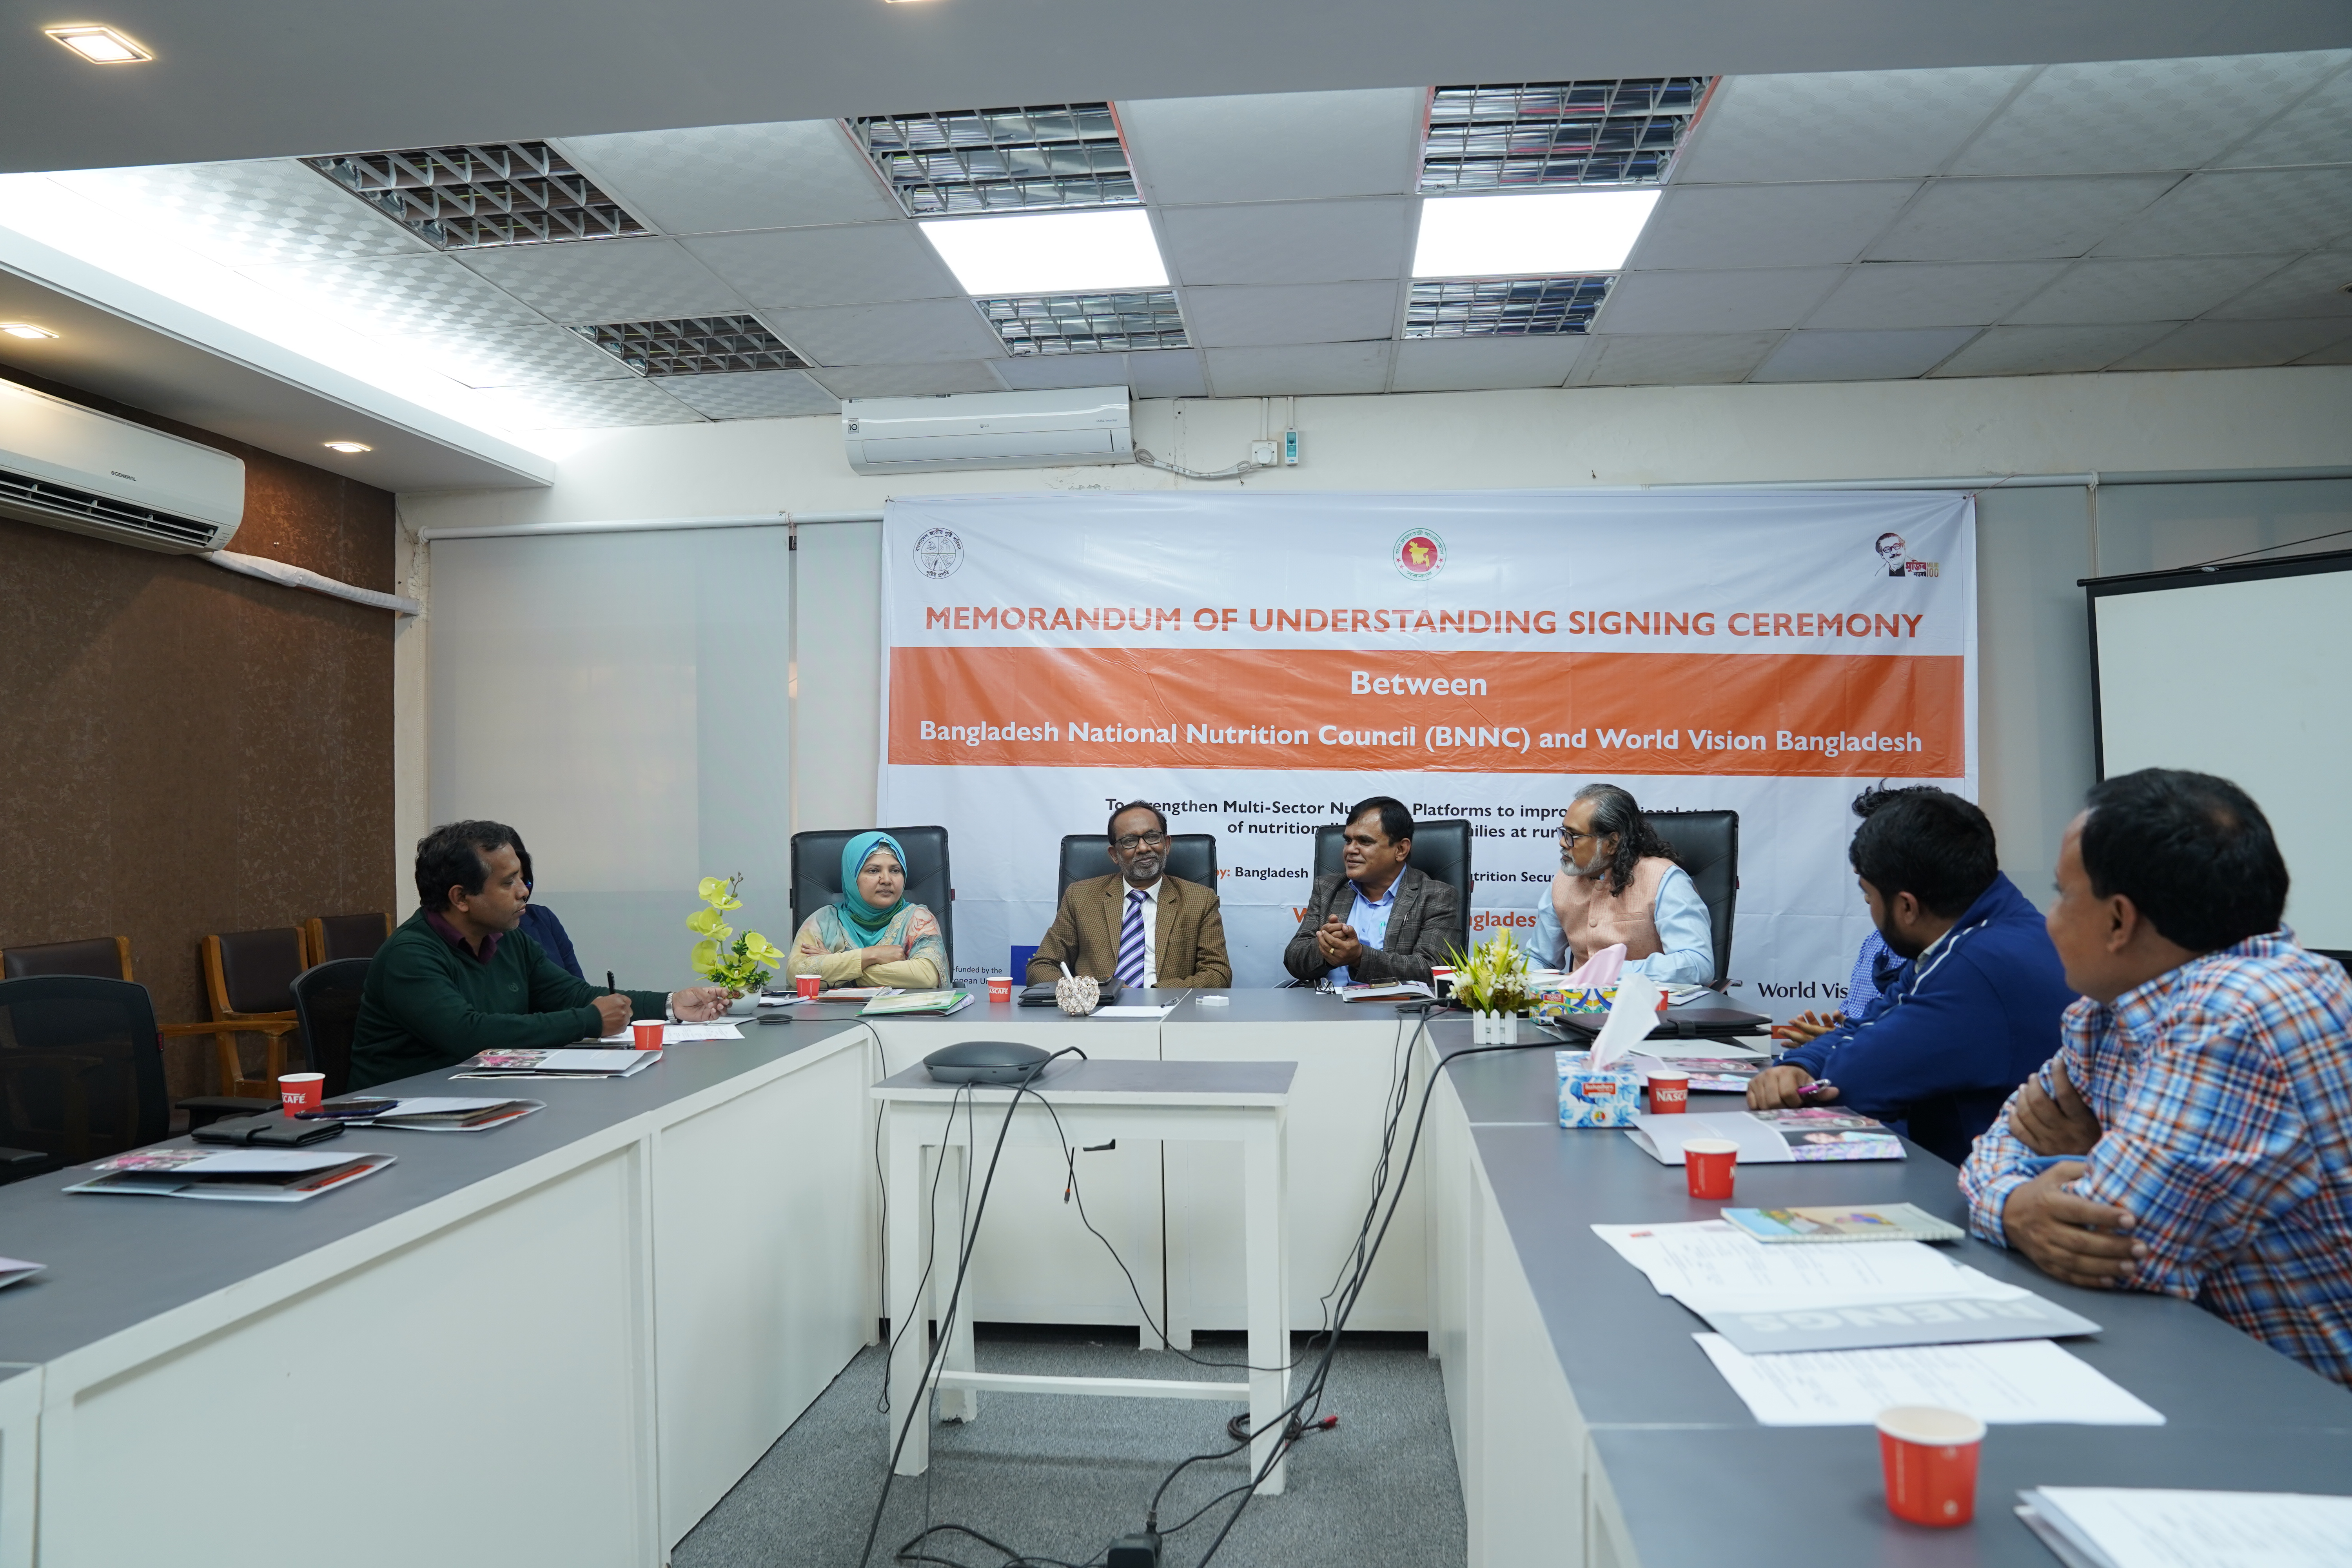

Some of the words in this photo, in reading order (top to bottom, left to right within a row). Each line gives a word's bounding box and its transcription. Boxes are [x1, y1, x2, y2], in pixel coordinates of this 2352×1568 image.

[115, 472, 136, 481] GENERAL
[1425, 532, 1444, 555] বাংলাদেশ
[1906, 559, 1926, 572] মুজিব
[1927, 568, 1939, 577] 100
[926, 607, 1180, 631] MEMORANDUM
[1194, 608, 1237, 632] OF
[1250, 608, 1556, 634] UNDERSTANDING
[1570, 611, 1715, 635] SIGNING
[1728, 613, 1923, 637] CEREMONY
[1351, 671, 1487, 696] Between
[921, 721, 1058, 746] Bangladesh
[1069, 722, 1177, 743] National
[1187, 724, 1308, 744] Nutrition
[1318, 725, 1416, 746] Council
[1425, 726, 1530, 753] (BNNC)
[1540, 729, 1586, 748] and
[1596, 729, 1678, 750] World
[1688, 730, 1766, 750] Vision
[1777, 731, 1922, 757] Bangladesh
[1151, 800, 1218, 815] engthen
[1224, 800, 1325, 814] Multi-Sector
[1413, 803, 1491, 817] Platforms
[1497, 806, 1514, 817] to
[1521, 805, 1567, 821] impro
[1228, 821, 1243, 833] of
[1471, 825, 1504, 837] ilies
[1511, 827, 1526, 838] at
[1533, 829, 1557, 838] rur
[1217, 869, 1230, 879] y:
[1236, 867, 1308, 880] Bangladesh
[1521, 872, 1553, 882] Secu
[1470, 911, 1537, 931] glades
[1758, 981, 1815, 998] World
[1821, 982, 1849, 999] Vis
[282, 1093, 306, 1103] CAFÉ
[1656, 1090, 1688, 1102] NASC
